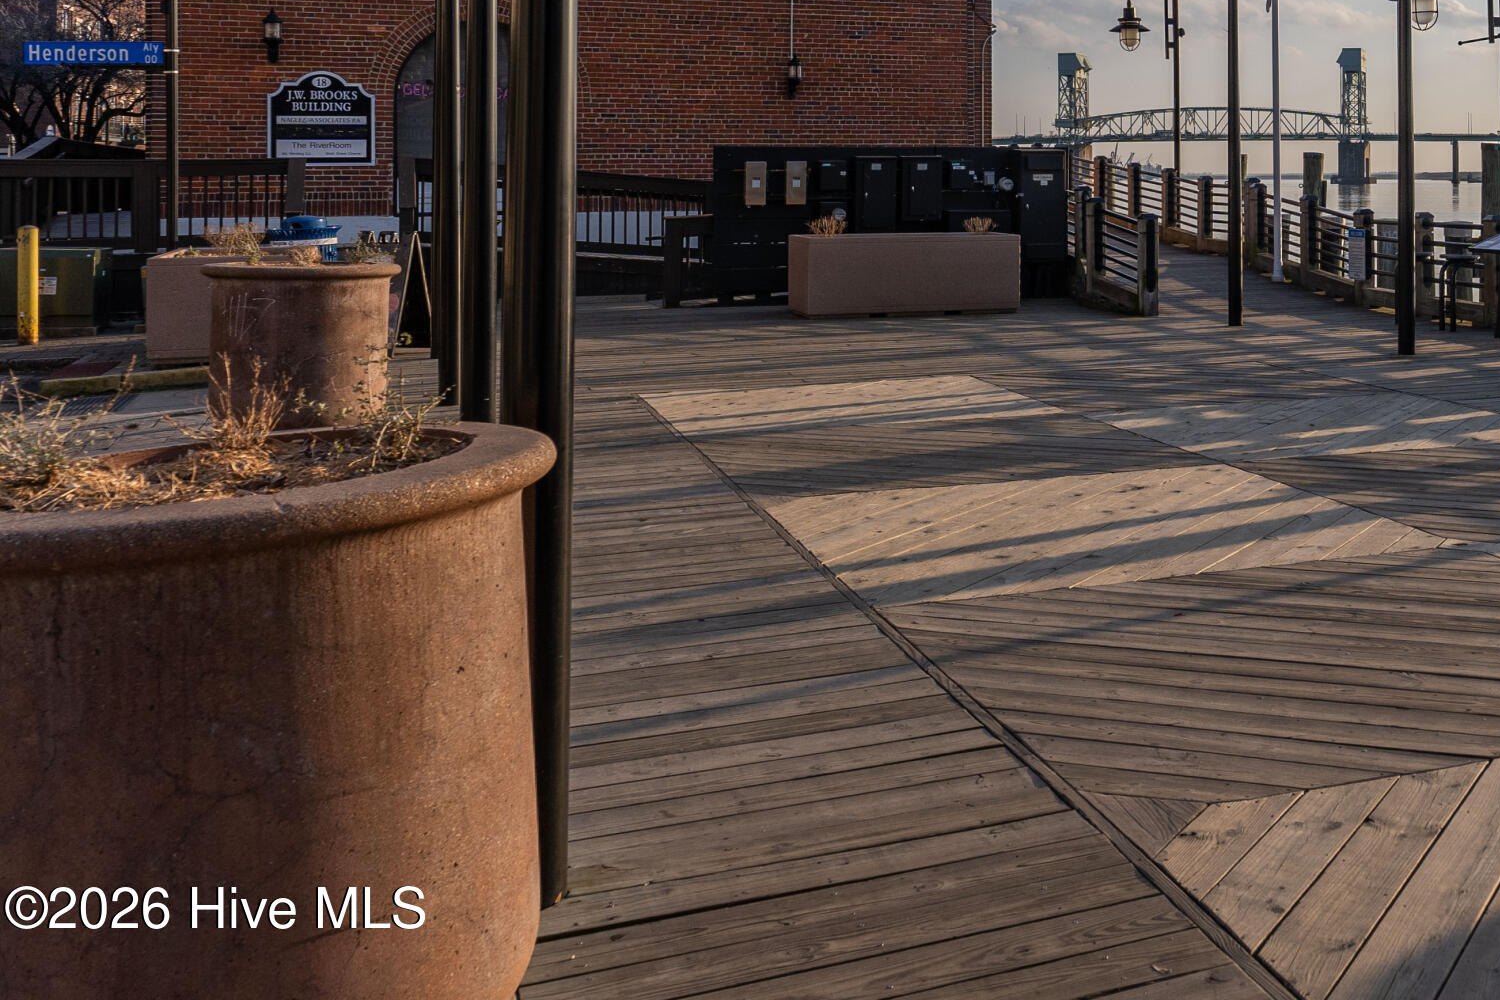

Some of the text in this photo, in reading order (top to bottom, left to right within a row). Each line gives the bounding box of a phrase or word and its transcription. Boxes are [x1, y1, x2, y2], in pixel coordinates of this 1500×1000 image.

[28, 44, 129, 62] Henderson
[143, 43, 159, 54] Aly
[144, 55, 158, 64] 00
[316, 78, 328, 87] 18
[286, 90, 358, 102] J.W. BROOKS
[292, 101, 352, 112] BUILDING
